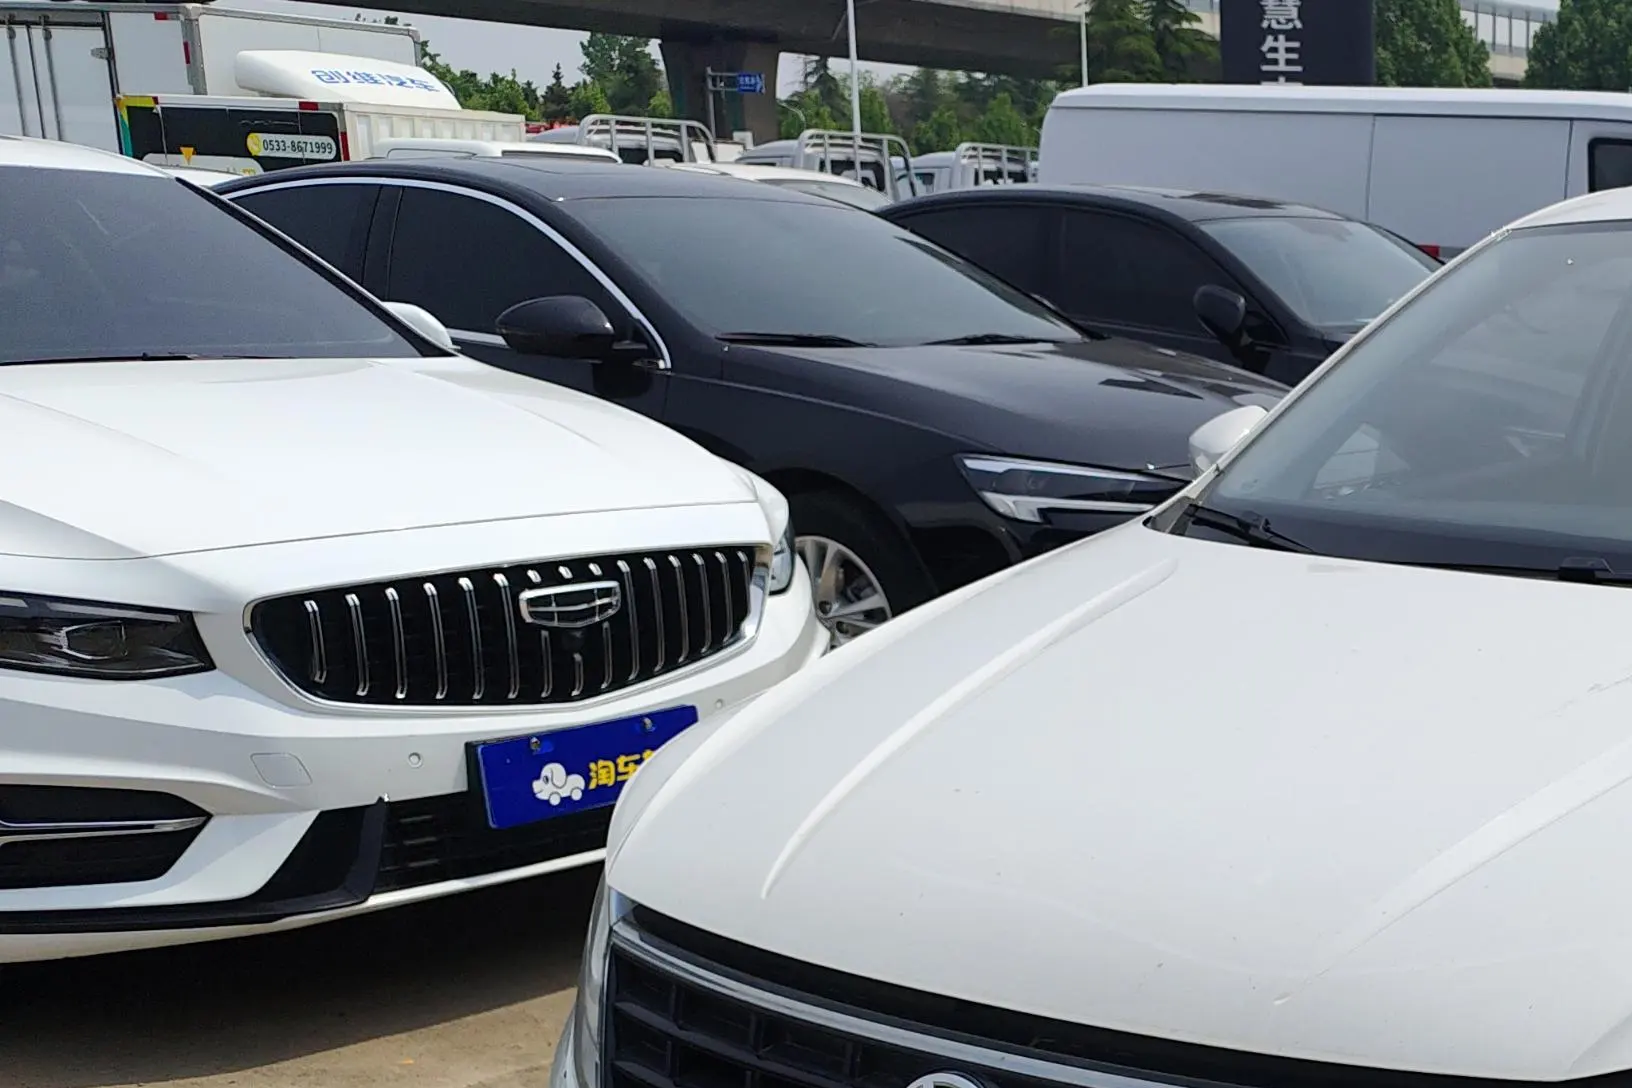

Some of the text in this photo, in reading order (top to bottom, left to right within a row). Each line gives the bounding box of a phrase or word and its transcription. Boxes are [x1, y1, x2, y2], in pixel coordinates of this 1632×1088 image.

[1260, 0, 1303, 86] 慧生
[310, 69, 440, 92] 创维汽车
[262, 138, 333, 155] 0533-8671999
[588, 749, 655, 790] 淘车
